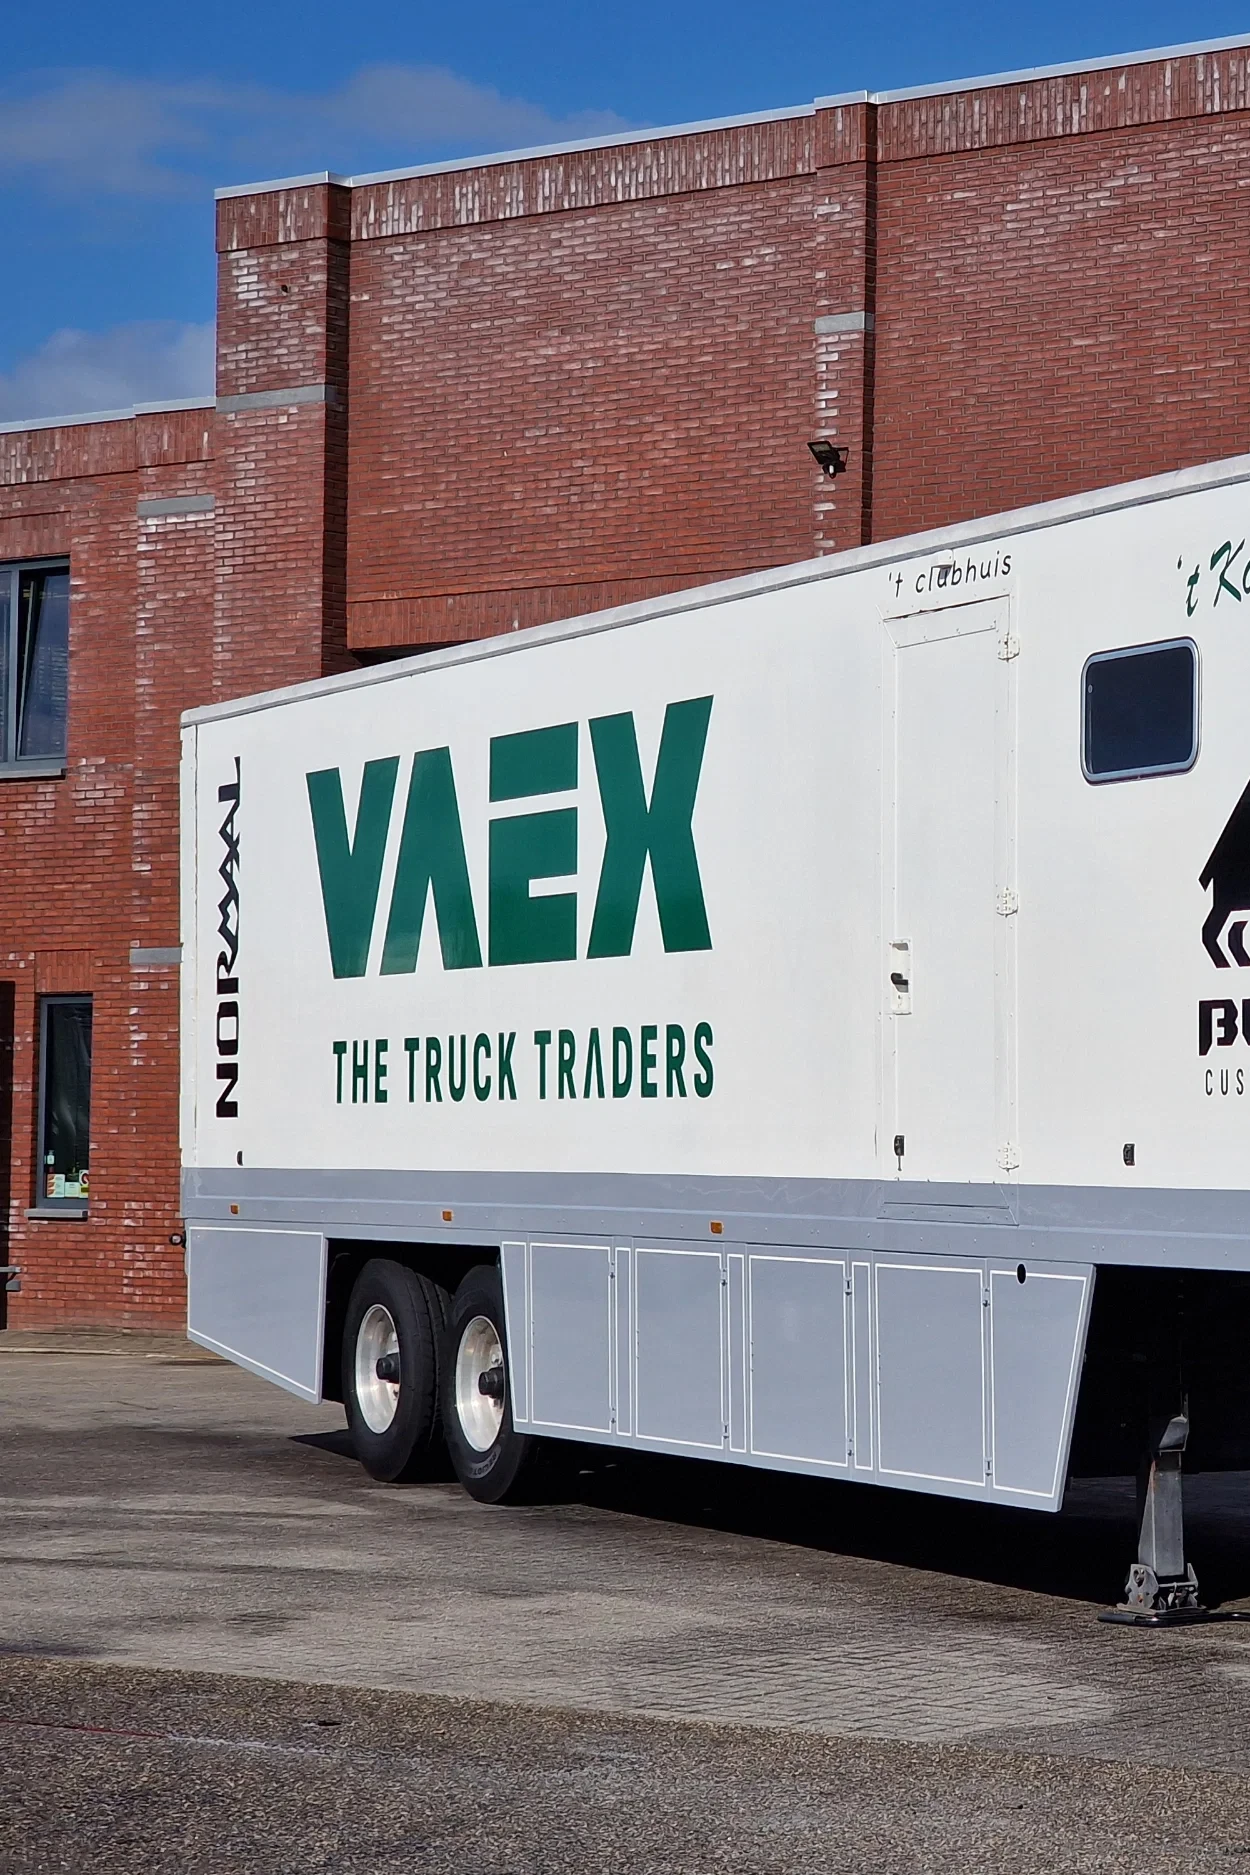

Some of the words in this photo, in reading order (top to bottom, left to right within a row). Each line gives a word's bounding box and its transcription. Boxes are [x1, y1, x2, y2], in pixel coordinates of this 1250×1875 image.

[915, 550, 1012, 594] clubhuis
[306, 694, 714, 980] VAEX
[216, 756, 241, 1118] NORMAAL
[332, 1038, 389, 1104] THE
[404, 1031, 517, 1103] TRUCK
[534, 1021, 714, 1100] TRADERS
